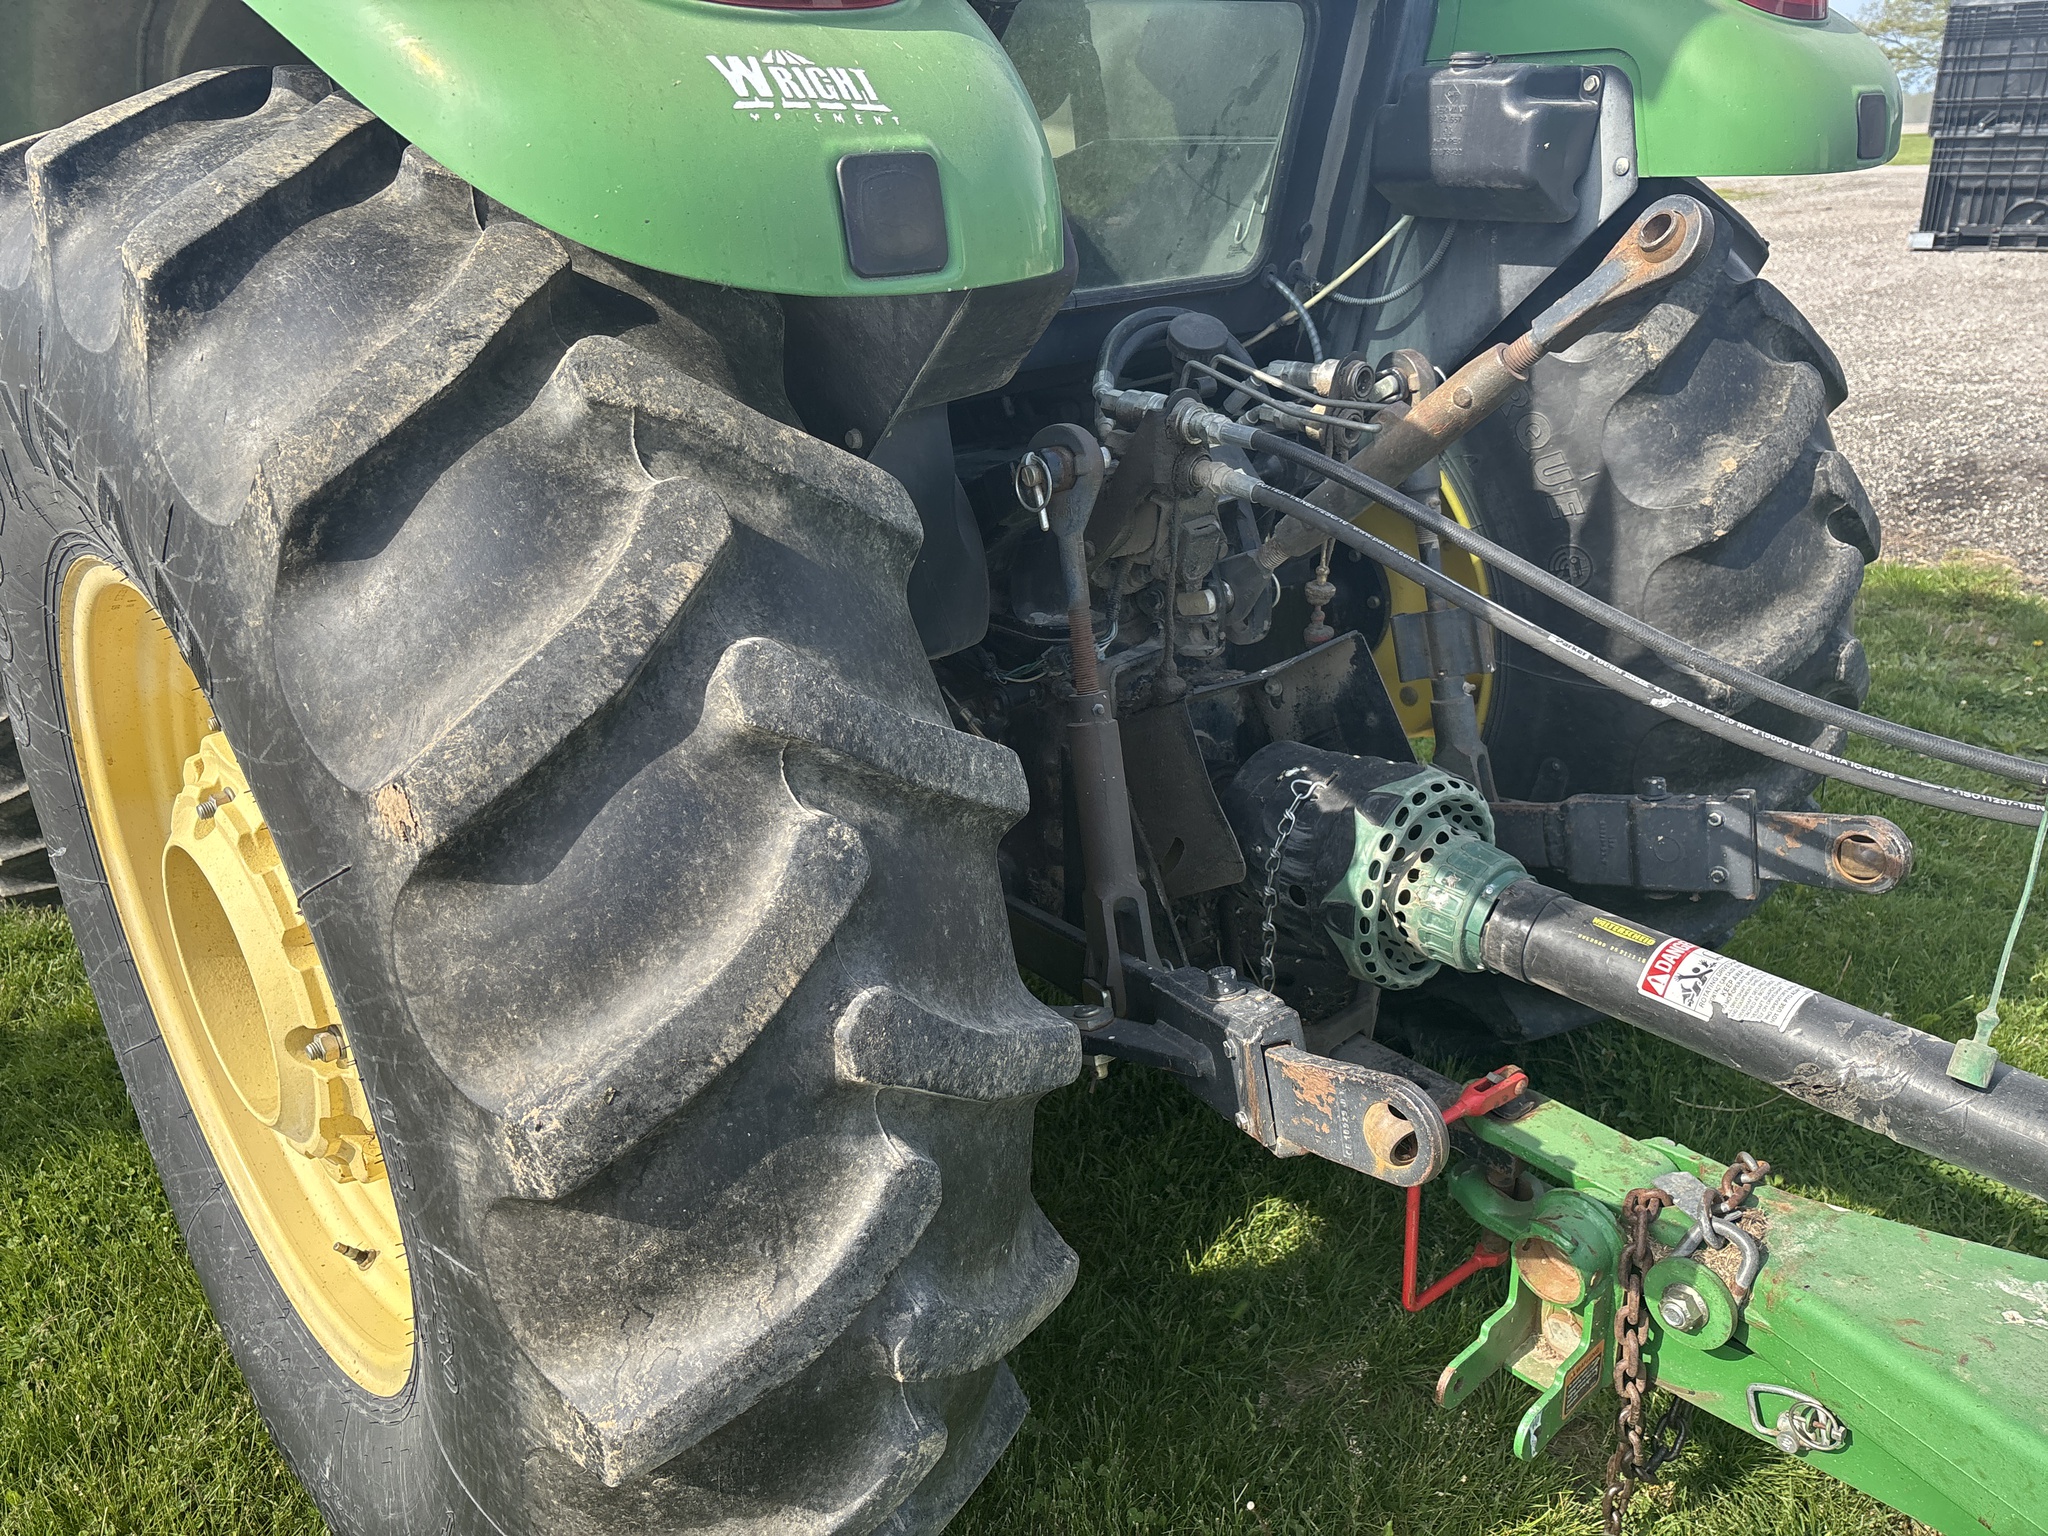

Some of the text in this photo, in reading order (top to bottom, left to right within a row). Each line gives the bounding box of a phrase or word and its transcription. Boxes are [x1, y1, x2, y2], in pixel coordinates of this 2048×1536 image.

[706, 55, 879, 101] WRIGHT
[1352, 525, 1417, 564] www.parker.com
[1553, 636, 1588, 658] Parker
[1736, 720, 1759, 735] MPa
[1815, 749, 1848, 766] MSHA
[1592, 917, 1656, 946] WALTERSCHEID
[1654, 940, 1697, 974] DANGE
[1699, 977, 1719, 1008] ROTATING
[1720, 980, 1733, 997] KEEP
